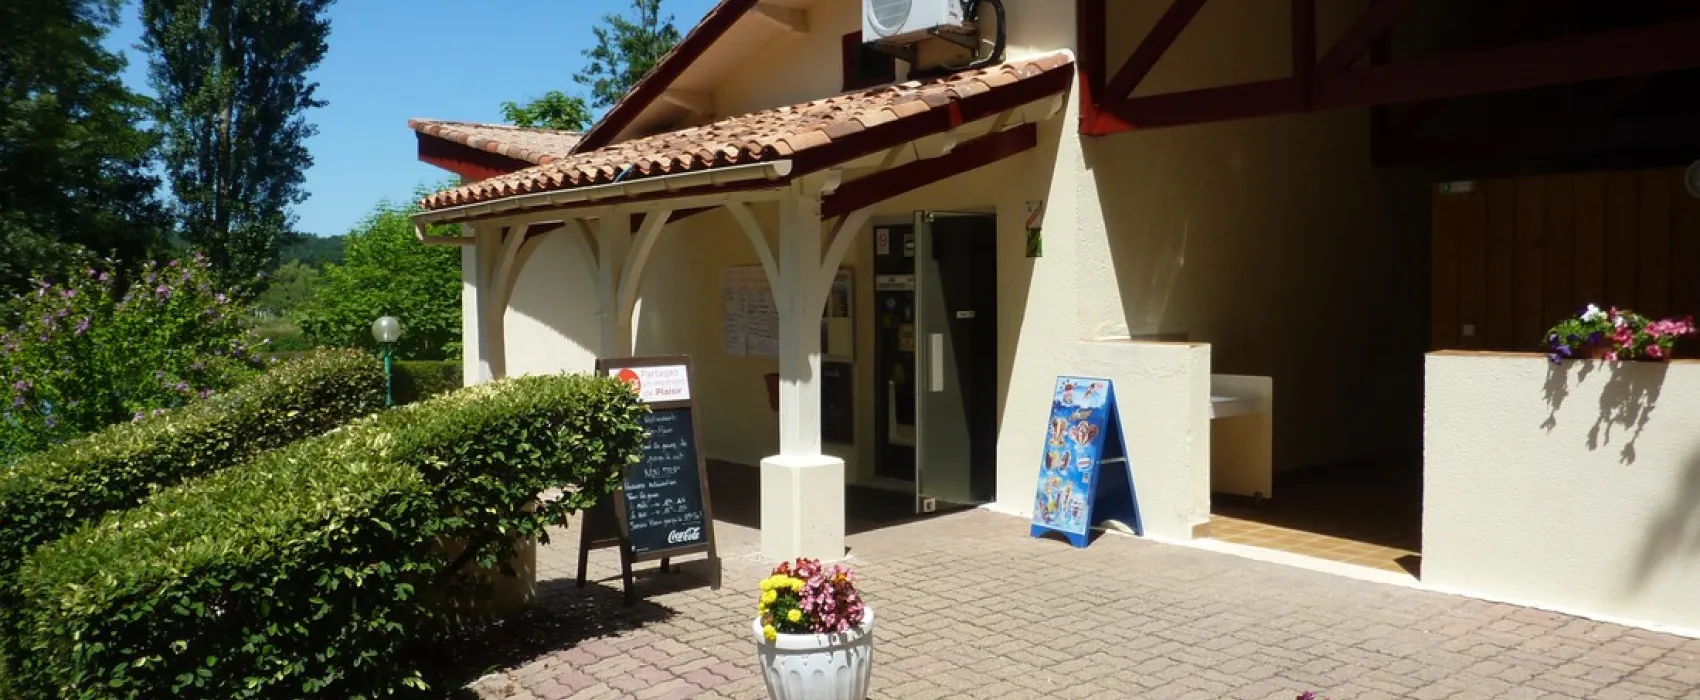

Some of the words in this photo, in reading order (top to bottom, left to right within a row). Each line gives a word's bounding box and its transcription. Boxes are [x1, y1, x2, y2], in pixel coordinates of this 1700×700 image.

[641, 369, 679, 378] Partagez
[656, 387, 682, 396] Plaisir
[668, 527, 700, 543] Coca-Cola
